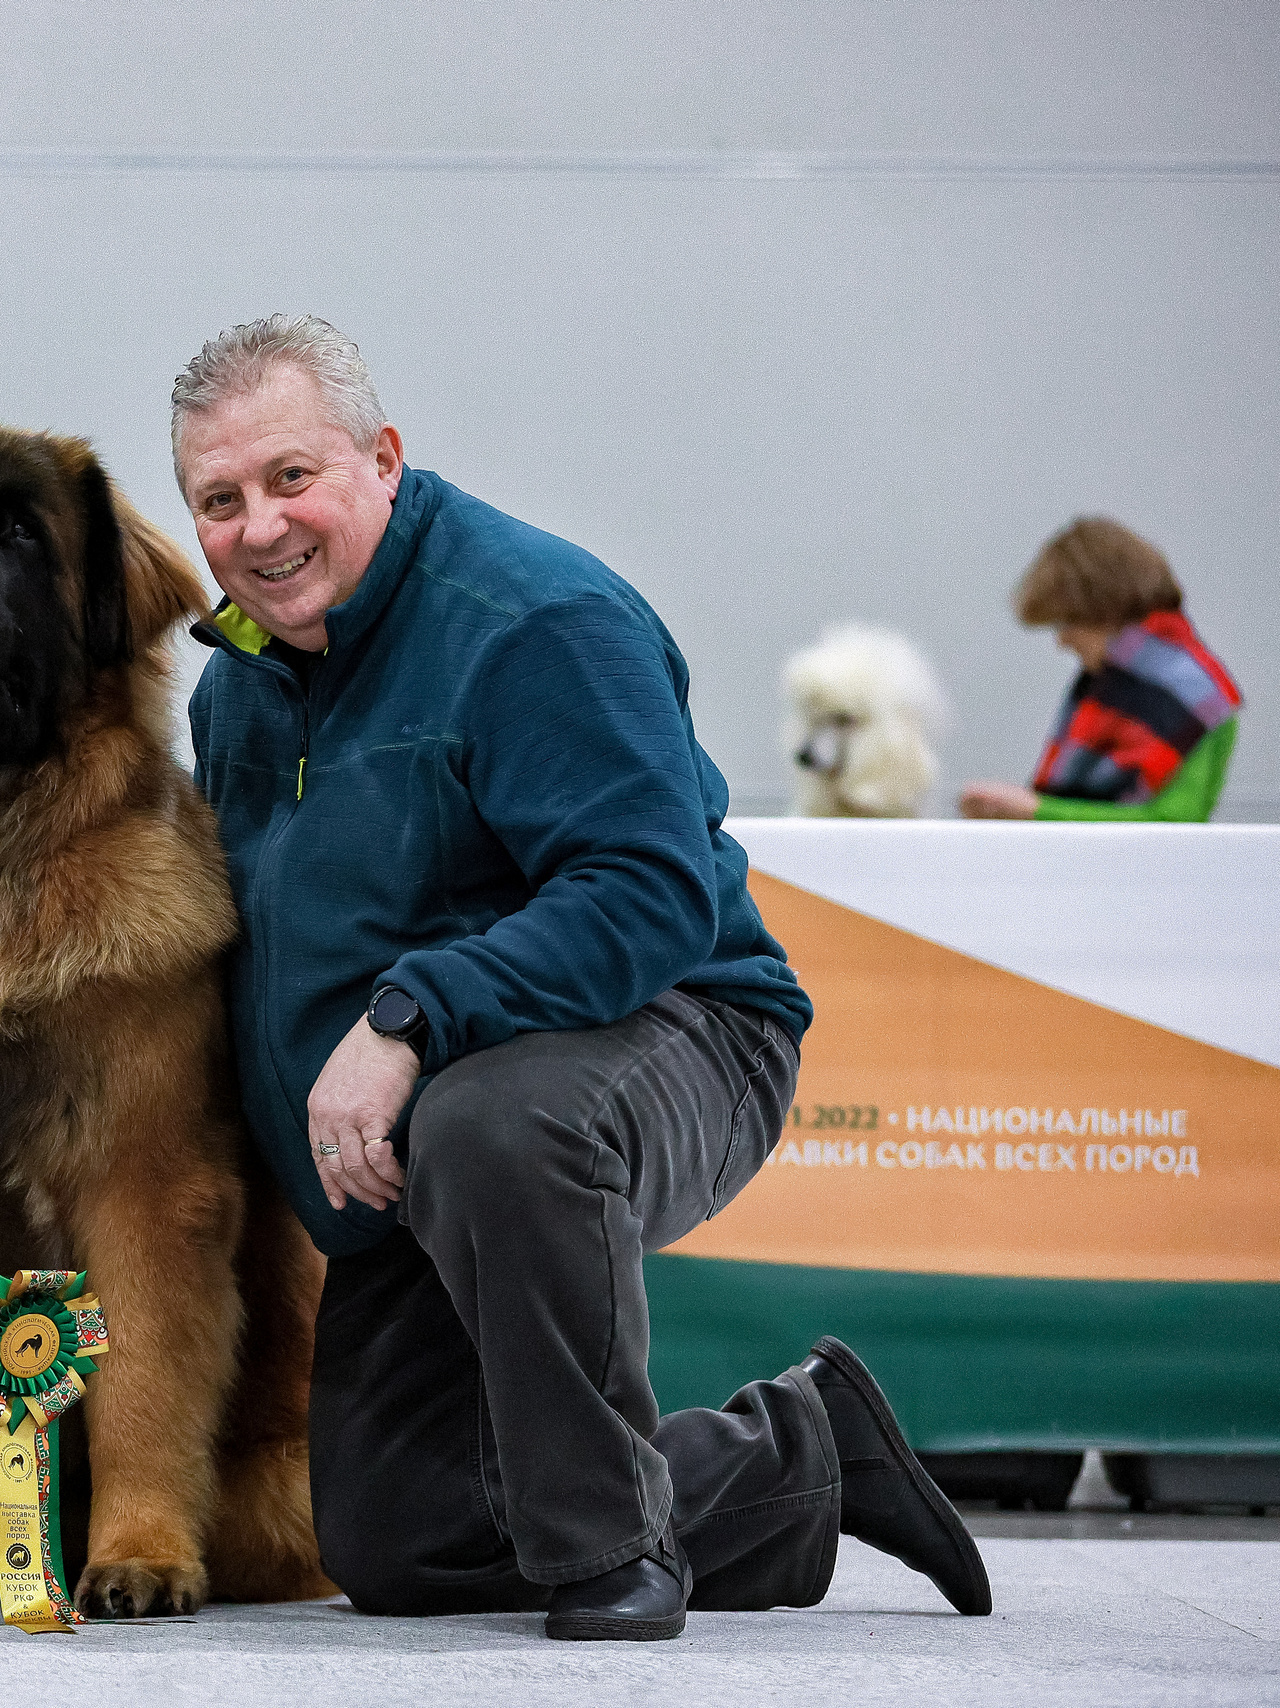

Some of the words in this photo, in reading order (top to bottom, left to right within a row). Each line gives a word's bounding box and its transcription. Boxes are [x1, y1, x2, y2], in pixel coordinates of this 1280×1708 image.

[906, 1105, 1188, 1138] НАЦИОНАЛЬНЫЕ
[876, 1140, 986, 1169] СОБАК
[995, 1142, 1076, 1171] ВСЕХ
[1085, 1144, 1200, 1178] ПОРОД
[0, 1502, 38, 1510] Национальная
[8, 1517, 29, 1525] собак
[14, 1594, 34, 1602] РКФ
[10, 1610, 44, 1618] КУБОК
